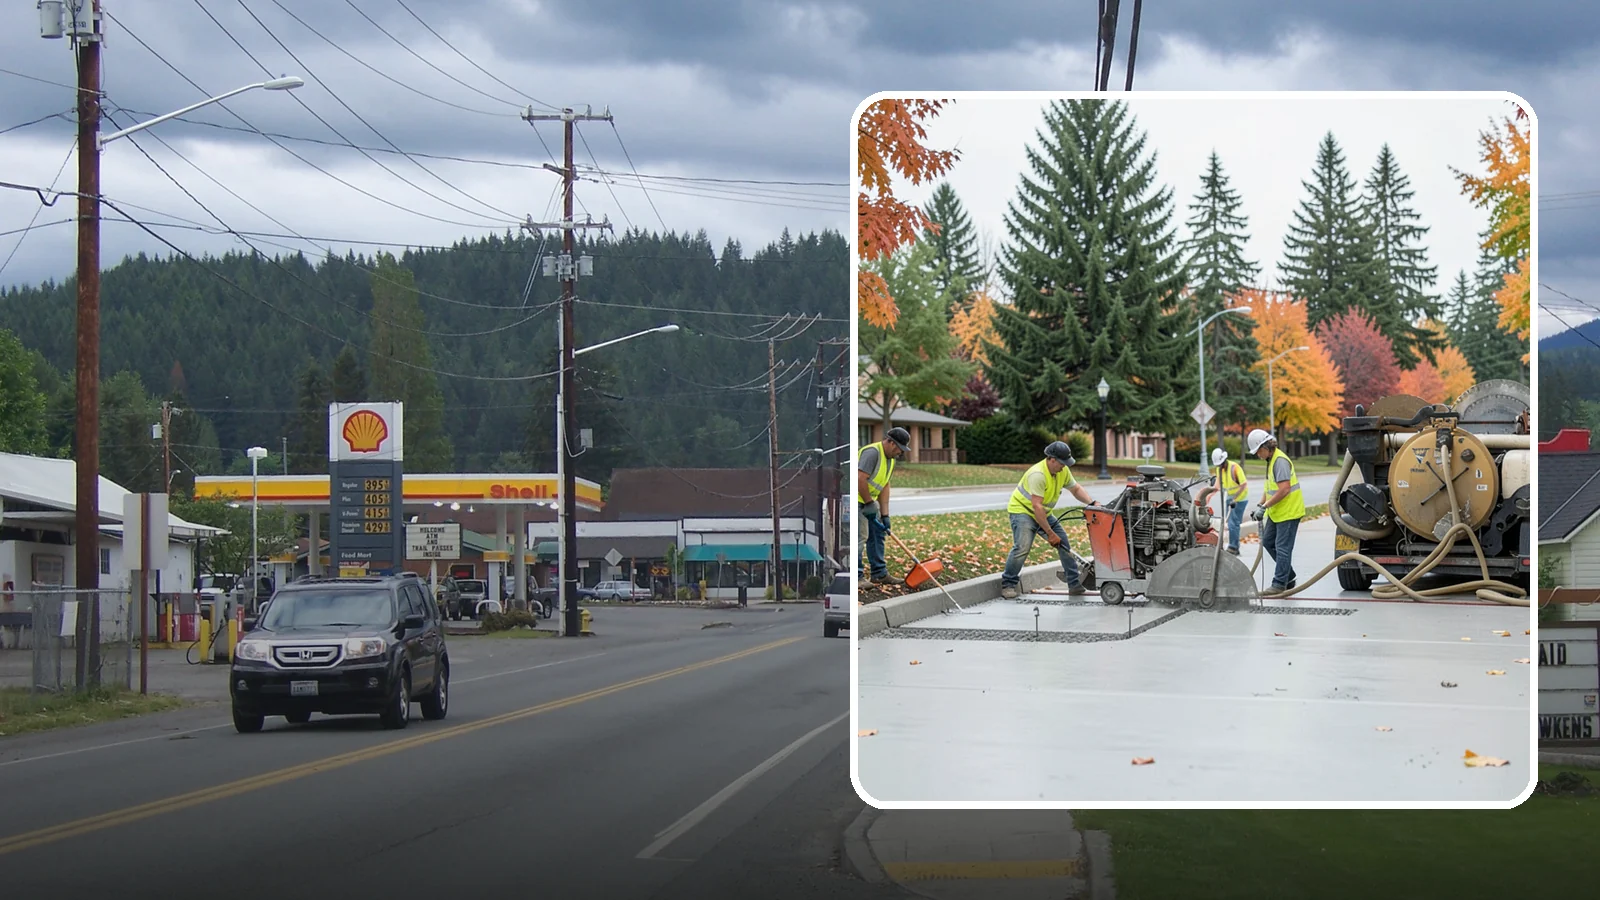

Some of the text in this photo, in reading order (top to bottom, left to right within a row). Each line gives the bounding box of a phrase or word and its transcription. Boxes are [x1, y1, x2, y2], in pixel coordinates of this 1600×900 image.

[366, 480, 383, 490] 395
[490, 484, 547, 498] Shell
[366, 494, 383, 504] 405
[366, 508, 383, 518] 415
[366, 522, 383, 532] 429
[1539, 643, 1567, 665] AID
